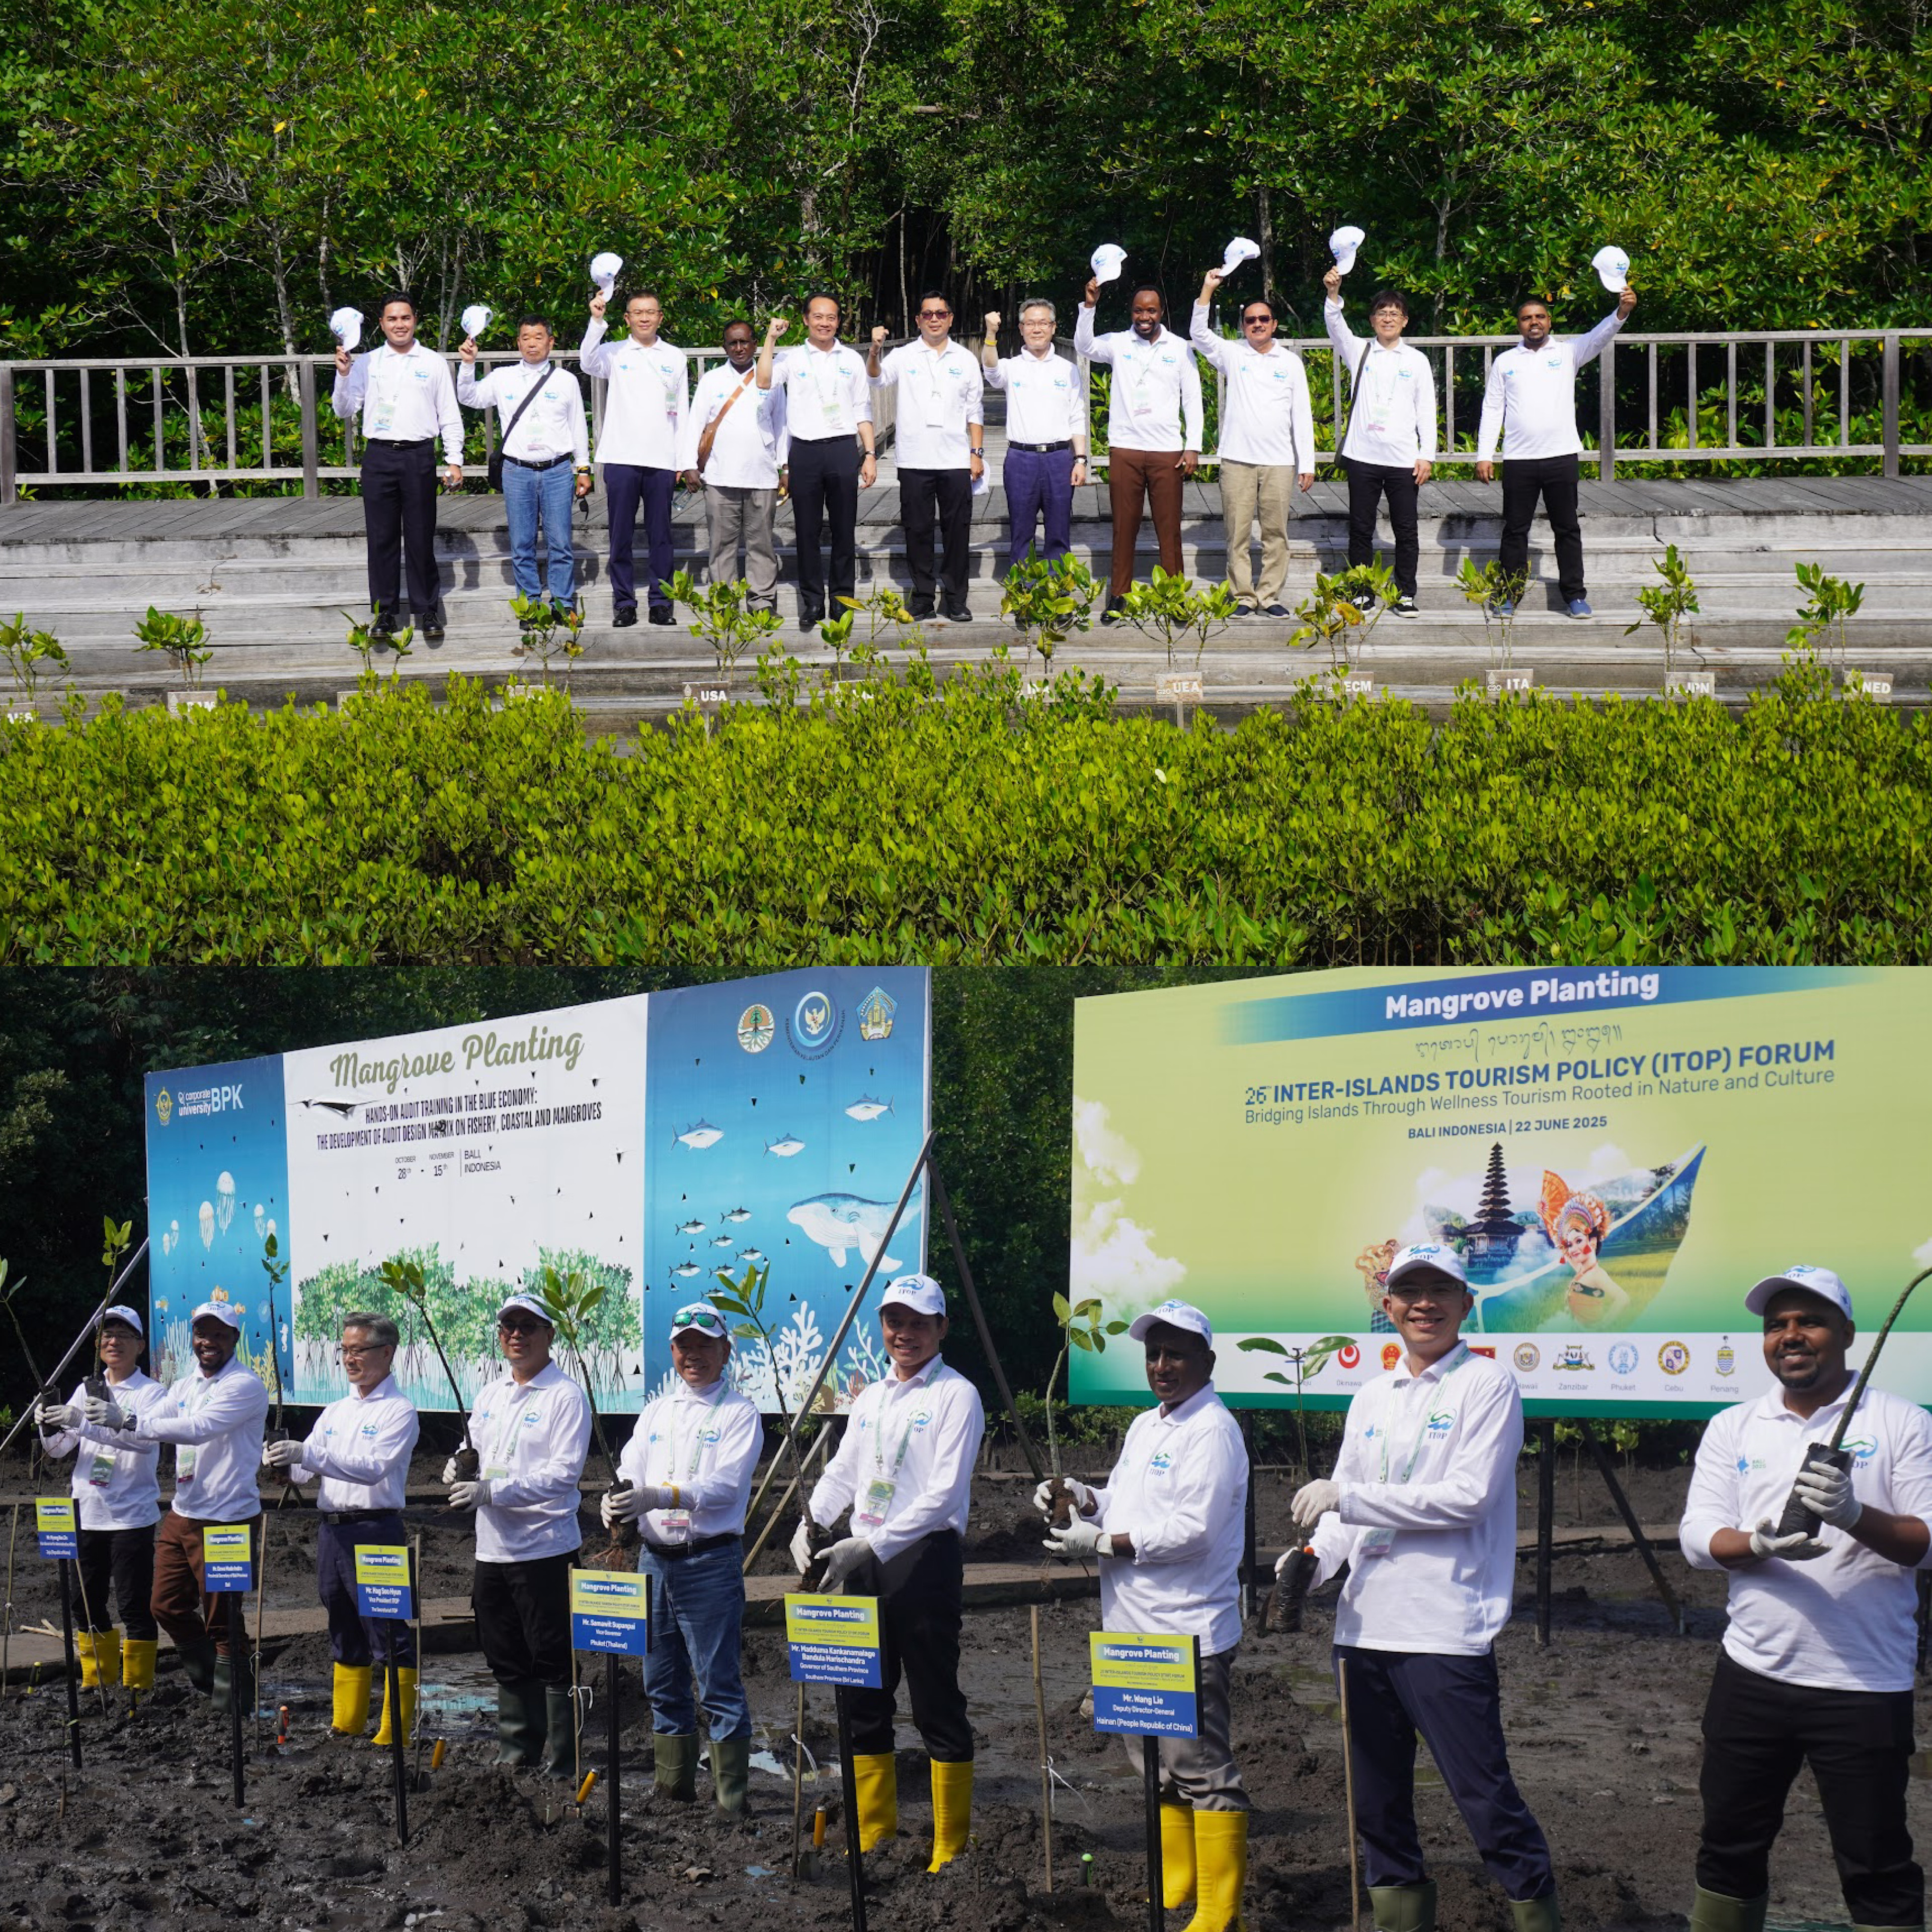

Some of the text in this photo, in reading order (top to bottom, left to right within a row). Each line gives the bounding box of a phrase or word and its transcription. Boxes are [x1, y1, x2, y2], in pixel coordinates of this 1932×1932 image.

[1173, 682, 1199, 692] UEA
[1344, 680, 1371, 692] ECM
[1507, 679, 1530, 689] ITA
[1685, 682, 1709, 693] JPN
[1863, 682, 1891, 693] NED
[701, 690, 727, 701] USA
[1386, 971, 1659, 1020] Mangrove Planting
[330, 1026, 585, 1094] Mangrove Planting
[1274, 1072, 1440, 1103] INTER-ISLANDS
[1445, 1063, 1549, 1090] TOURISM
[1556, 1056, 1646, 1082] POLICY
[1651, 1045, 1731, 1078] (ITOP)
[1739, 1039, 1834, 1067] FORUM
[185, 1089, 211, 1102] corporate
[211, 1083, 244, 1112] BPK
[1245, 1068, 1834, 1125] Bridging Islands Through Wellness Tourism Rooted in Nature and Culture
[179, 1102, 211, 1116] university
[366, 1087, 537, 1124] HANDS-ON AUDIT TRAINING IN THE BLUE ECONOMY:
[317, 1134, 328, 1150] THE
[330, 1129, 372, 1149] DEVELOPMENT
[374, 1128, 382, 1145] OF
[383, 1125, 401, 1144] AUDIT
[403, 1122, 426, 1142] DESIGN
[455, 1118, 465, 1136] ON
[467, 1114, 499, 1135] FISHERY,
[501, 1110, 534, 1131] COASTAL
[534, 1107, 551, 1127] AND
[552, 1101, 602, 1125] MANGROVES
[1409, 1116, 1607, 1139] BALI INDONESIA 22 JUNE 2025
[429, 1152, 455, 1160] NOVEMBER
[464, 1160, 501, 1173] INDONESIA
[1711, 1385, 1739, 1394] Penang
[581, 1582, 637, 1595] Mangrove Planting
[796, 1607, 865, 1621] Mangrove Planting
[1103, 1647, 1179, 1662] Mangrove Planting
[1122, 1694, 1134, 1703] Mr.
[1134, 1695, 1152, 1706] Wang
[1096, 1717, 1193, 1733] Hainan (People Republic of China)
